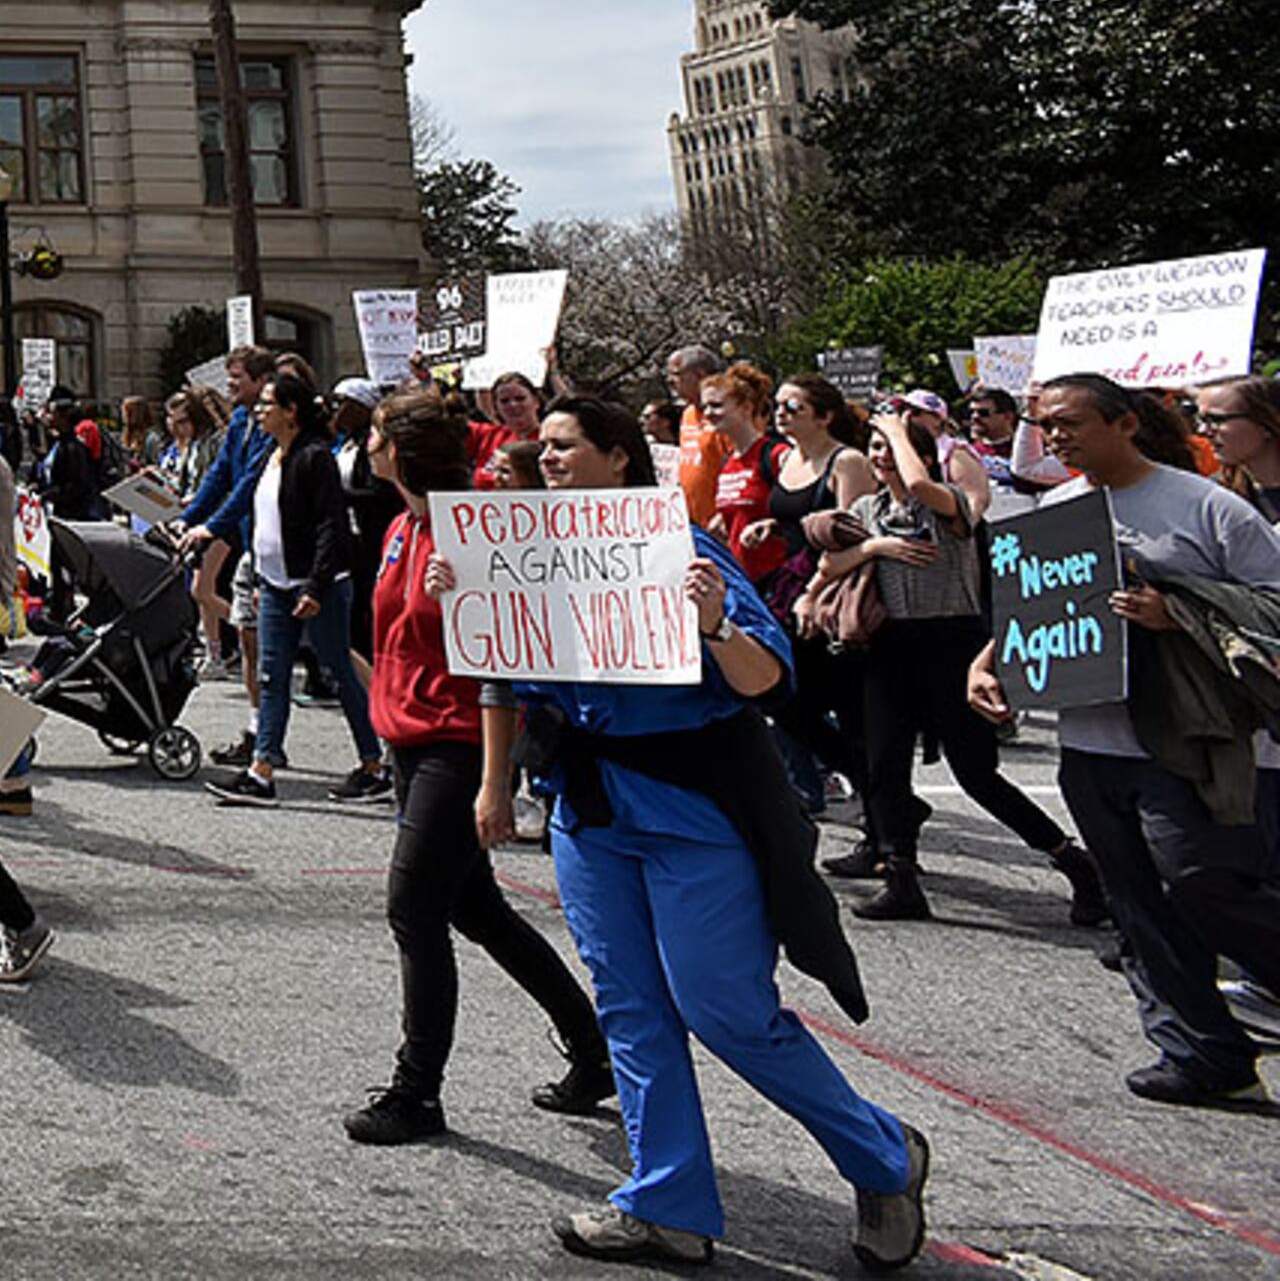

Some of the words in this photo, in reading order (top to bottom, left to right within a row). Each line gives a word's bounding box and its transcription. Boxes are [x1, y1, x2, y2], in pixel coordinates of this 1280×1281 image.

[1056, 276, 1090, 295] THE
[1097, 268, 1152, 292] ONLY
[1154, 256, 1248, 284] WEAPON
[437, 285, 462, 310] 96
[1048, 293, 1150, 321] TEACHERS
[1157, 284, 1246, 307] SHOULD
[1060, 325, 1115, 347] NEED
[1118, 323, 1137, 341] IS
[1142, 320, 1158, 337] A
[489, 542, 648, 585] AGAINST
[453, 591, 557, 672] GUN
[568, 585, 697, 671] VIOLEN
[1002, 602, 1102, 692] Again
